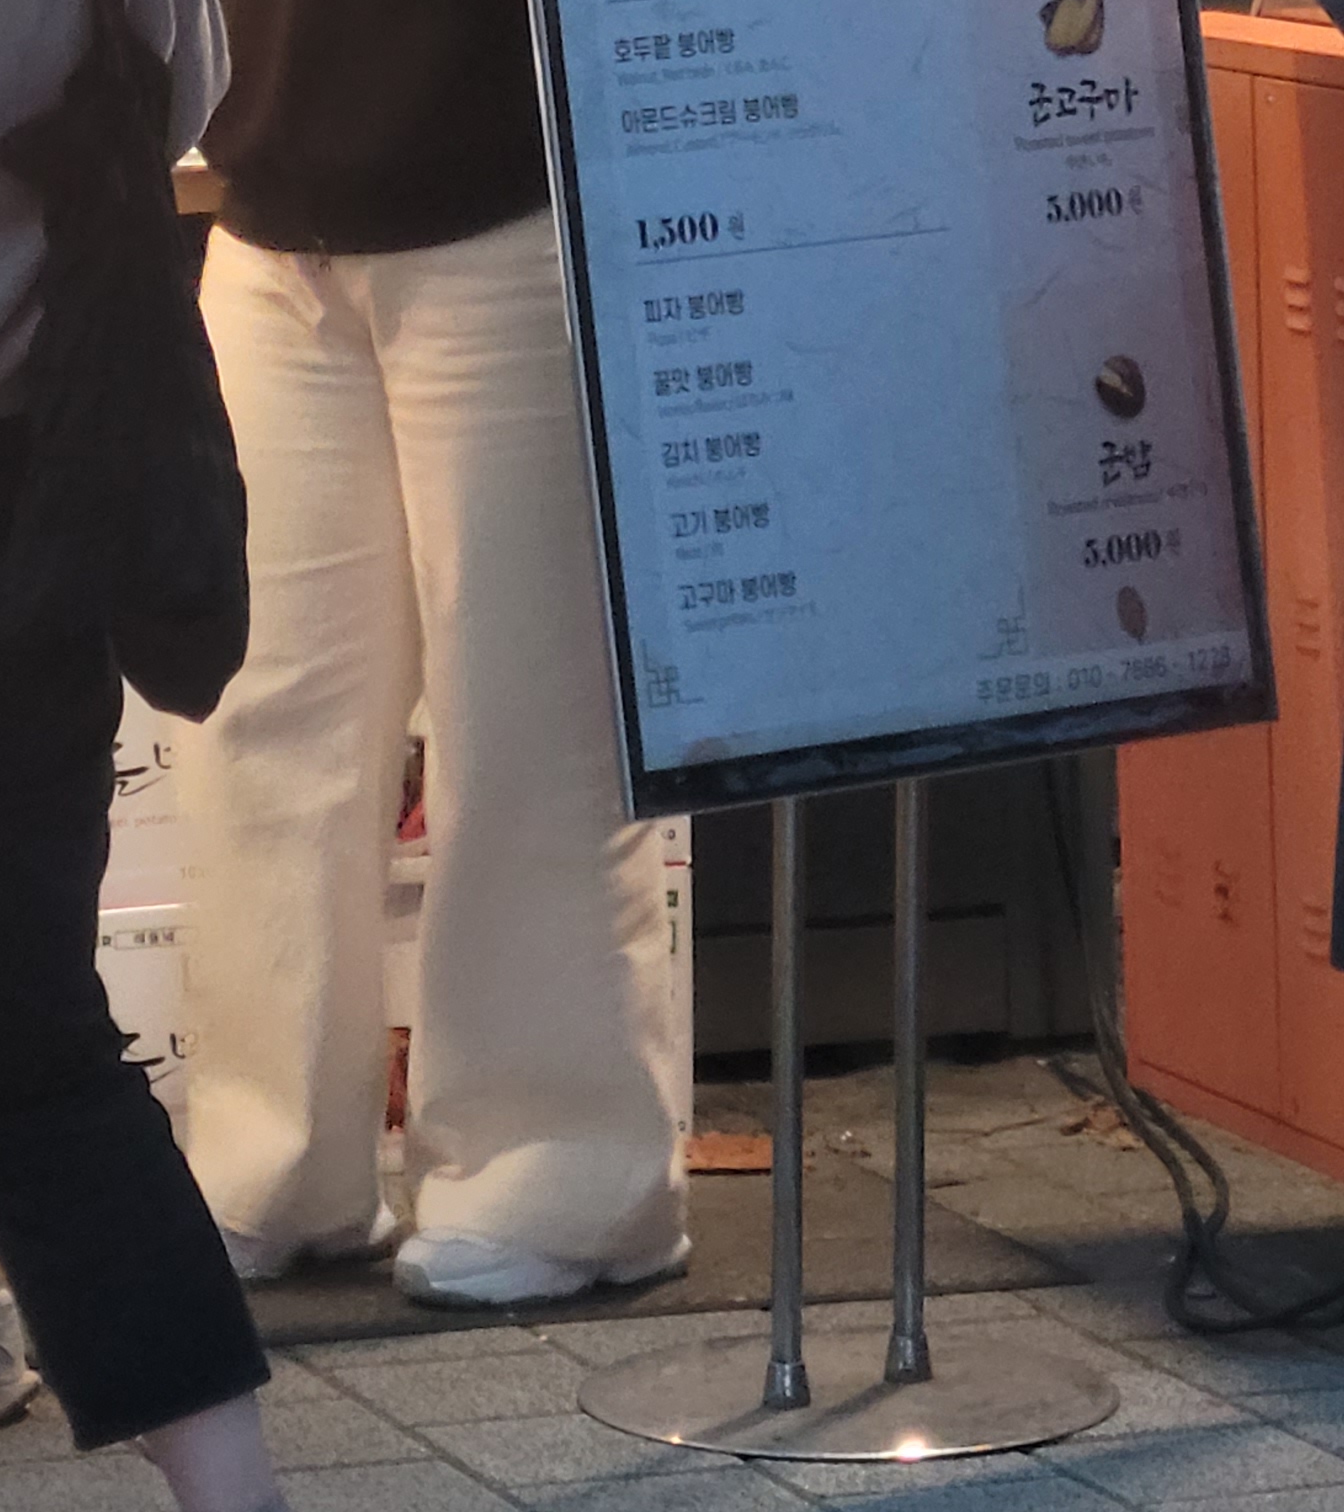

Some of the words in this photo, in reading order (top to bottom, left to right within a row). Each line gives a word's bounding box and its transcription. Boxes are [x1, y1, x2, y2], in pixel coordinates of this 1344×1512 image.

[614, 33, 671, 63] 호두팥
[678, 28, 735, 59] 붕어빵
[622, 100, 736, 134] 아몬드슈크림
[743, 92, 799, 123] 붕어빵
[1029, 77, 1138, 127] 군고구마
[636, 211, 719, 253] 1,500
[643, 297, 681, 322] 피자
[688, 288, 744, 319] 붕어빵
[697, 360, 753, 390] 붕어빵
[662, 439, 699, 468] 김치
[705, 432, 761, 462] 붕어빵
[1098, 440, 1152, 487] 군밤
[671, 510, 707, 538] 고기
[714, 502, 770, 533] 붕어빵
[678, 579, 735, 610] 고구마
[741, 571, 797, 601] 붕어빵
